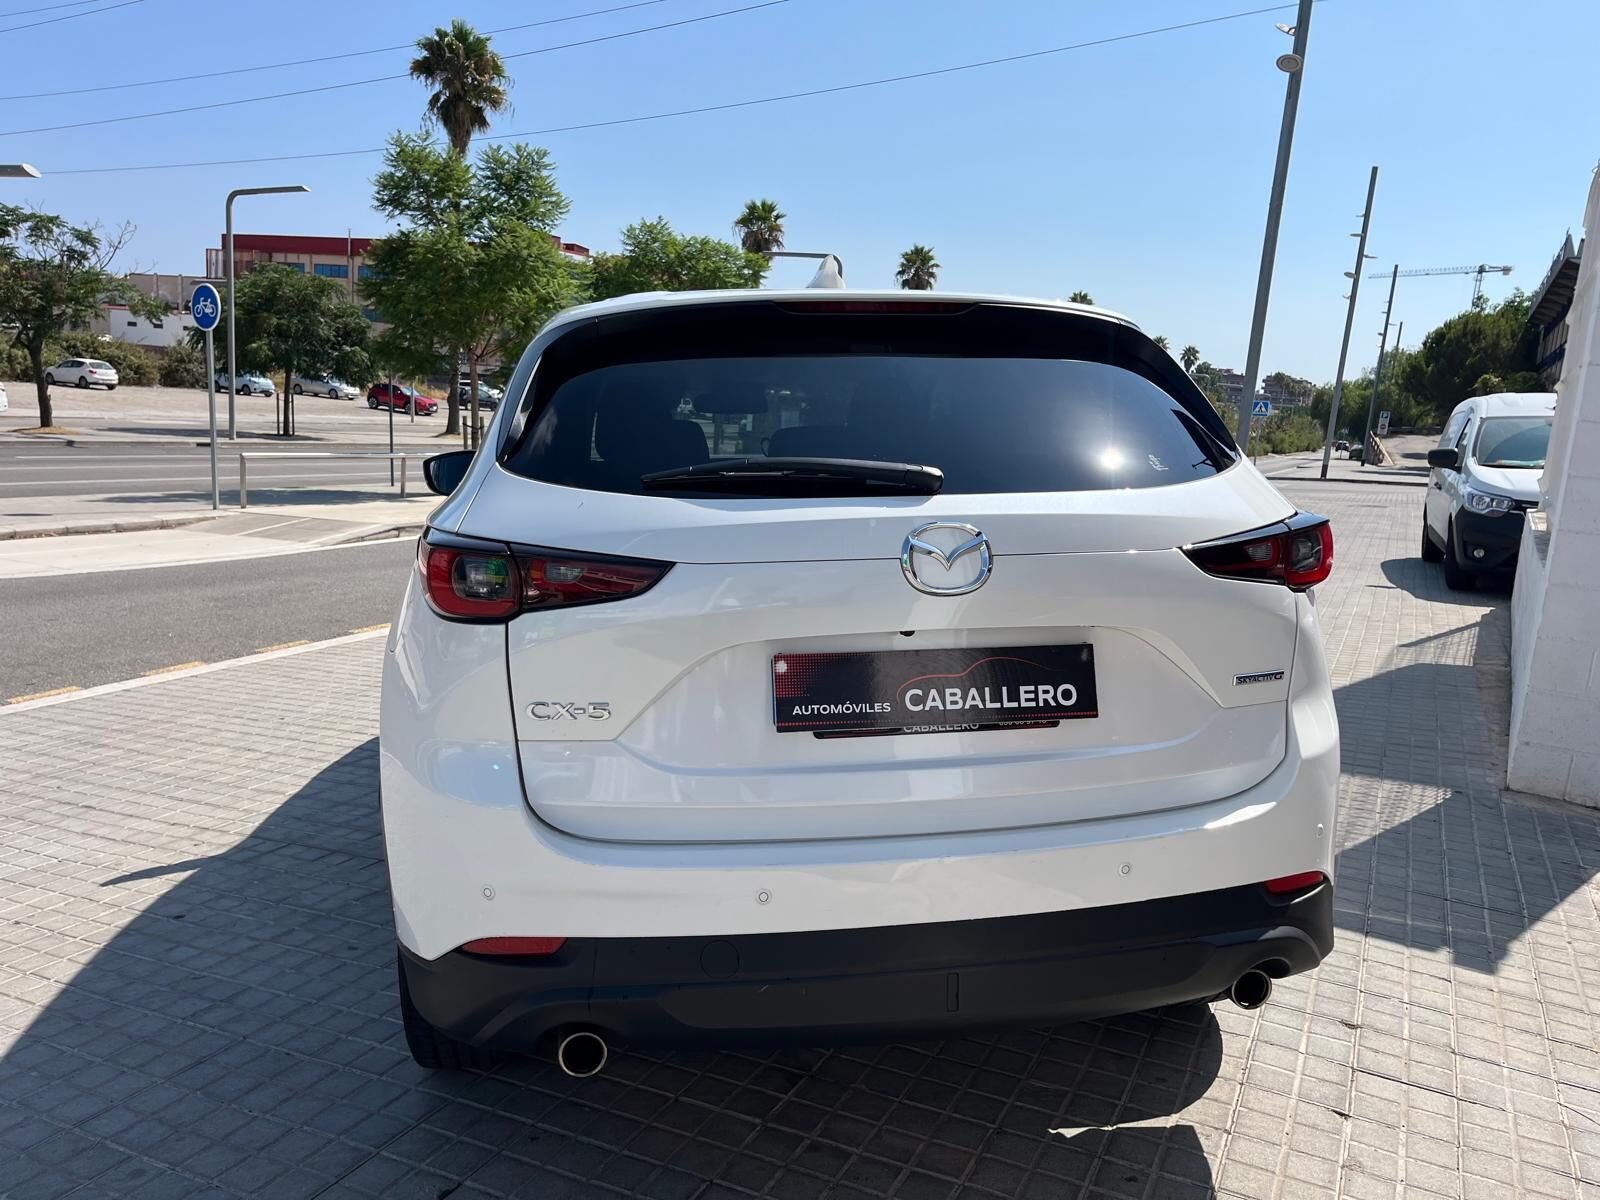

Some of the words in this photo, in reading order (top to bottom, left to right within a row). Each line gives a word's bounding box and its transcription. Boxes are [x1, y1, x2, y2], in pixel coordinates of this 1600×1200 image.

[526, 701, 611, 721] CX-5
[792, 700, 892, 716] AUTOMÓVILES
[904, 683, 1078, 712] CABALLERO
